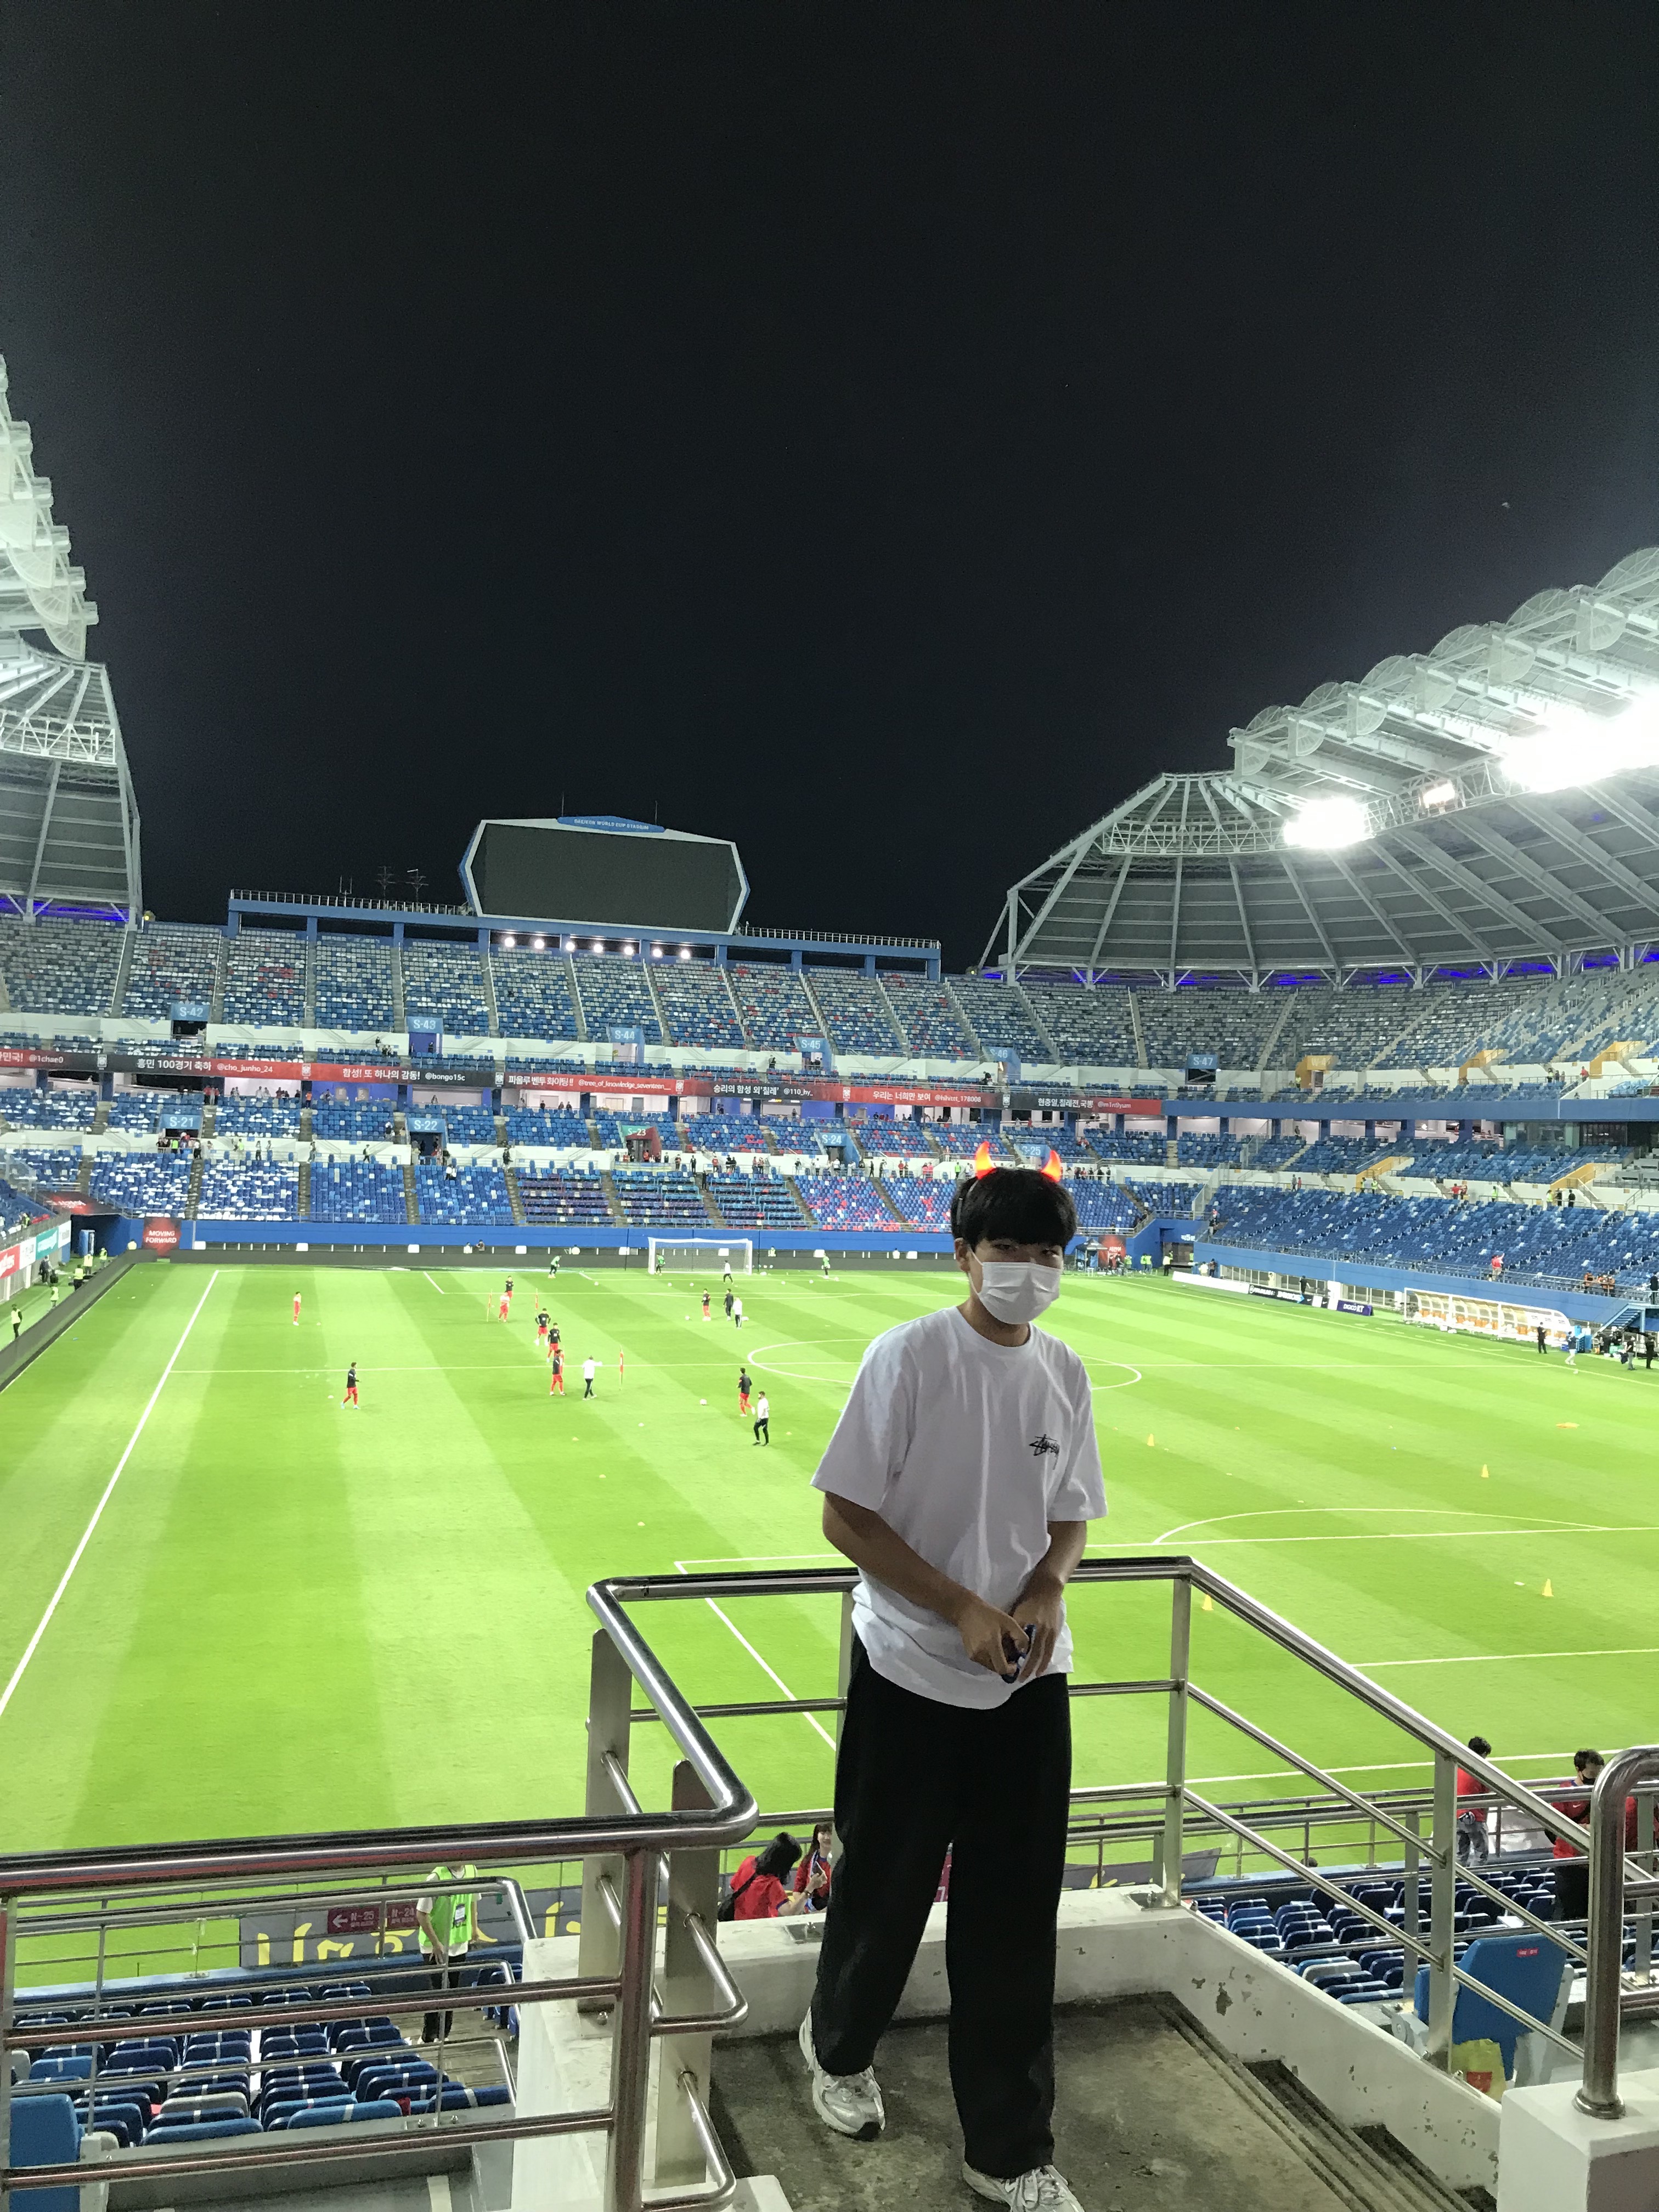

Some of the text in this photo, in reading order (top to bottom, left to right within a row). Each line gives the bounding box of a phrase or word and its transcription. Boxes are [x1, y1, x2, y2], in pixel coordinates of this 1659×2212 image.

[179, 1007, 203, 1018] S-42
[413, 1019, 436, 1030] S-43
[615, 1030, 635, 1040] S-44
[801, 1039, 821, 1049] S-45
[157, 1060, 192, 1070] 100경기
[194, 1061, 212, 1071] 축하
[217, 1063, 273, 1073] @cho_junho_24
[1193, 1057, 1213, 1066] S-47
[343, 1068, 466, 1081] 함성! 또 하나의 감동! @bongo15c
[508, 1075, 531, 1085] 파울루
[531, 1076, 546, 1086] 벤투
[737, 1085, 751, 1094] 함성
[873, 1091, 894, 1100] 우리는
[895, 1092, 916, 1101] 너희만
[917, 1093, 931, 1102] 보여
[170, 1116, 194, 1127] S-21
[414, 1120, 438, 1131] S-22
[628, 1128, 646, 1136] S-23
[822, 1135, 842, 1144] S-24
[351, 1911, 374, 1921] N-25
